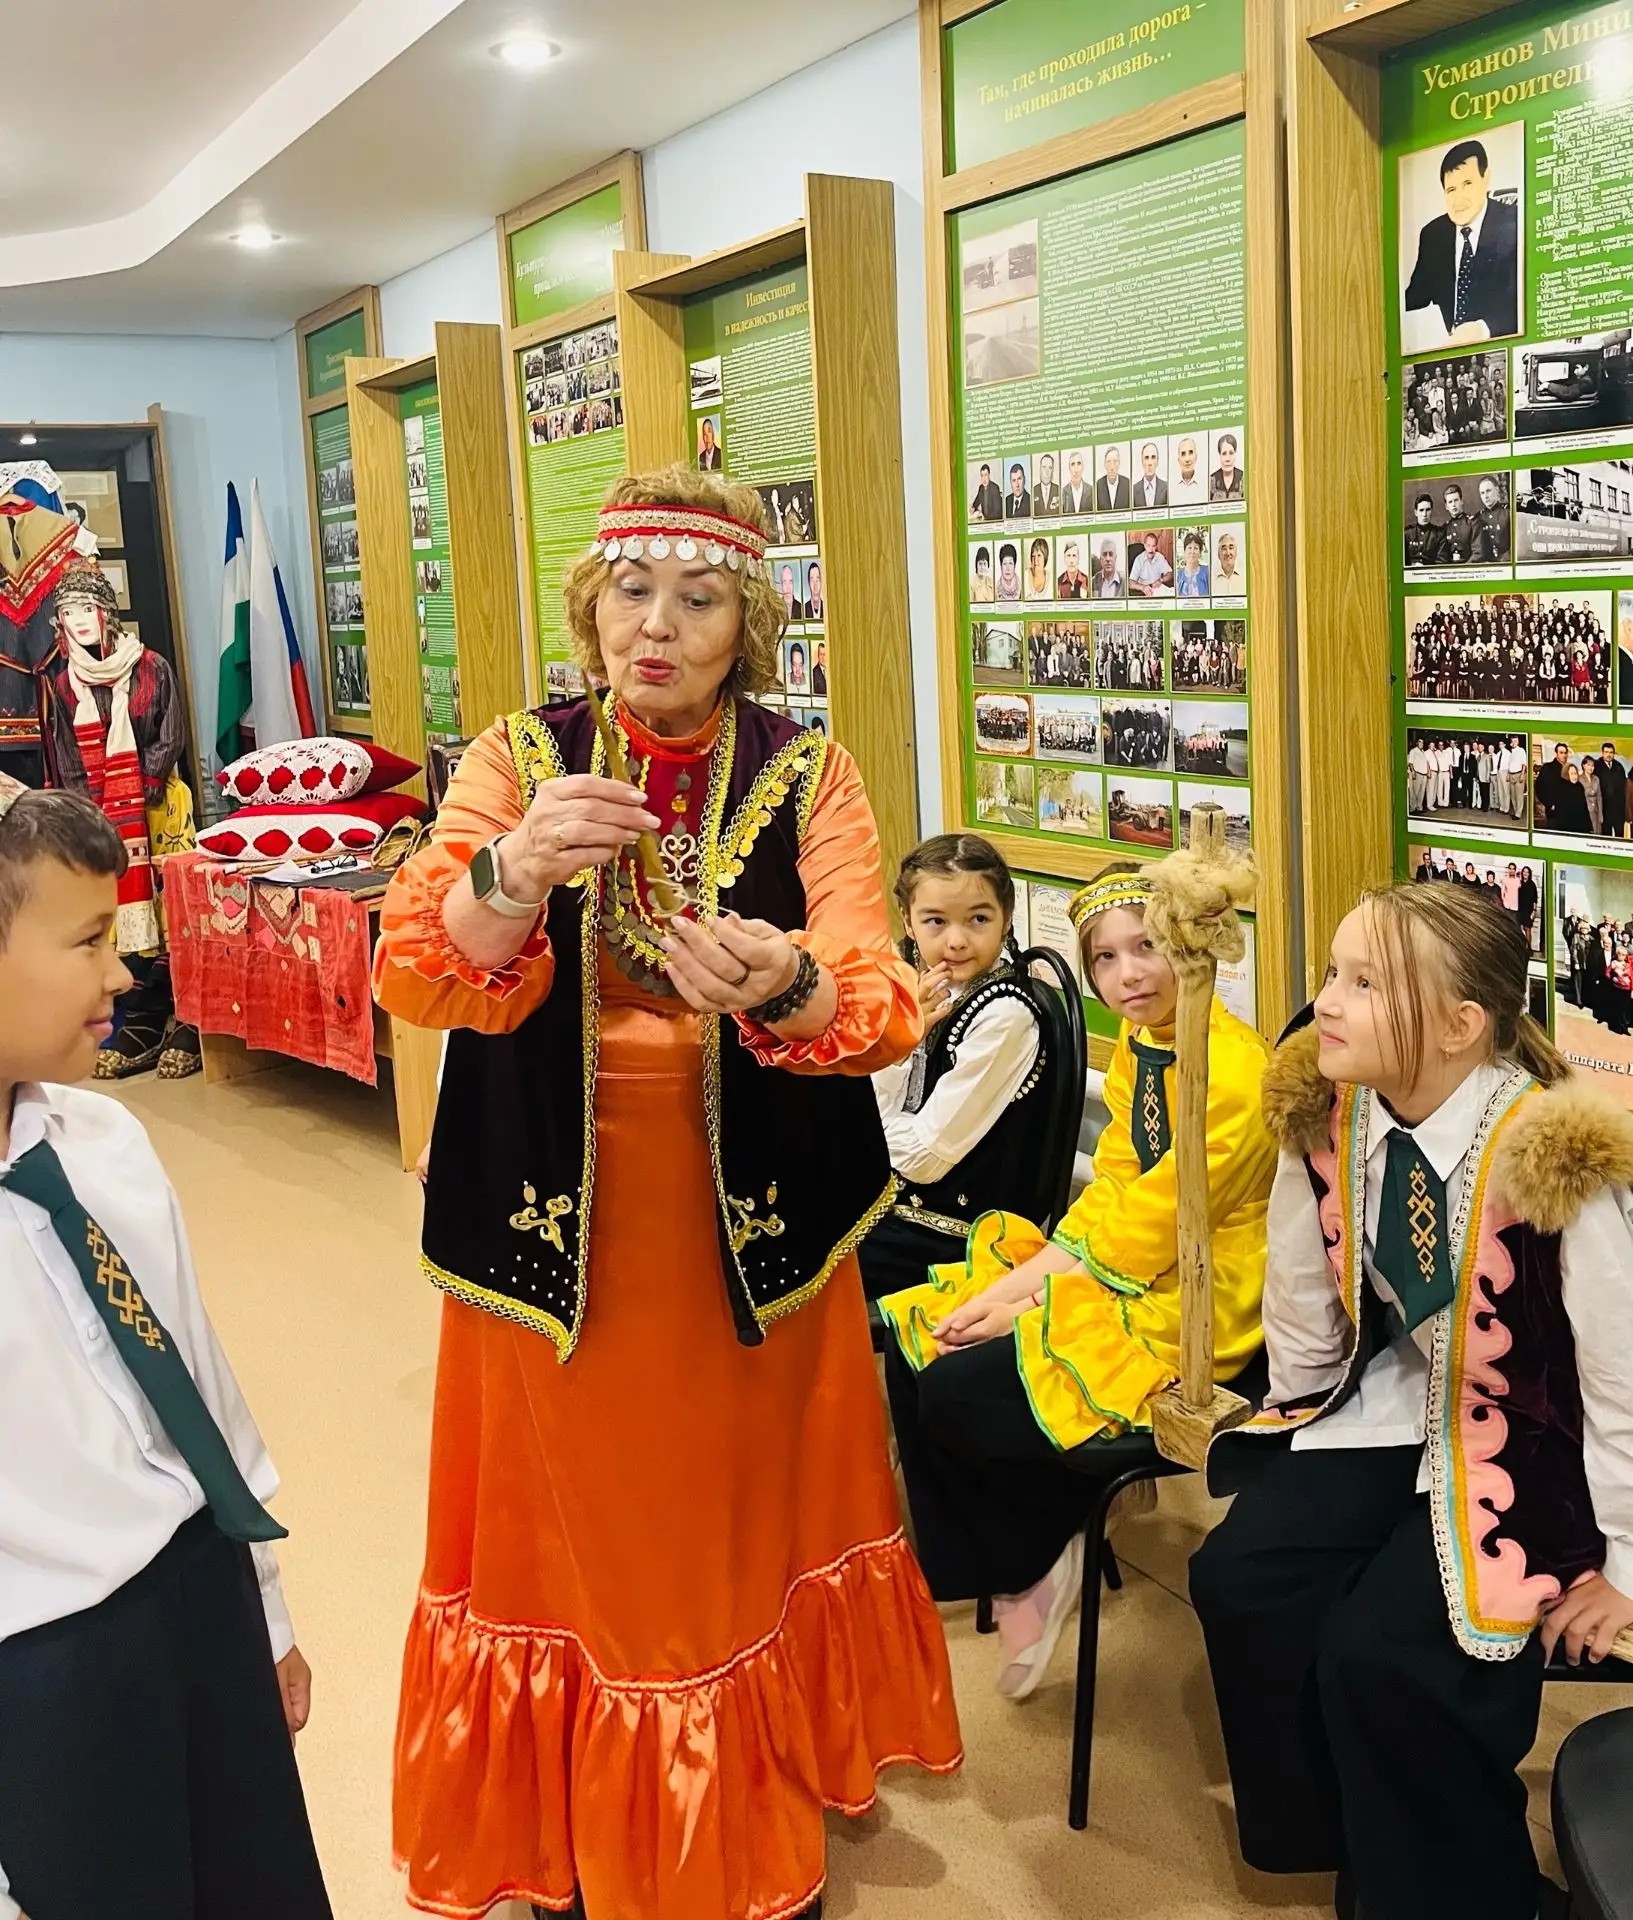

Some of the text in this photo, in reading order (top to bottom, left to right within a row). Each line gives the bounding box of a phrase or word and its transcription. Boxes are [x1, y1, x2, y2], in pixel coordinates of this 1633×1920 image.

[977, 84, 1009, 107] Там,
[1012, 70, 1036, 93] где
[1039, 32, 1126, 84] проходила
[1128, 3, 1191, 48] дорога
[1421, 9, 1632, 95] Усманов Мини
[1004, 76, 1093, 123] начиналась
[745, 282, 796, 308] Инвестиция
[724, 325, 730, 336] в
[730, 311, 777, 334] надежность
[779, 308, 784, 320] и
